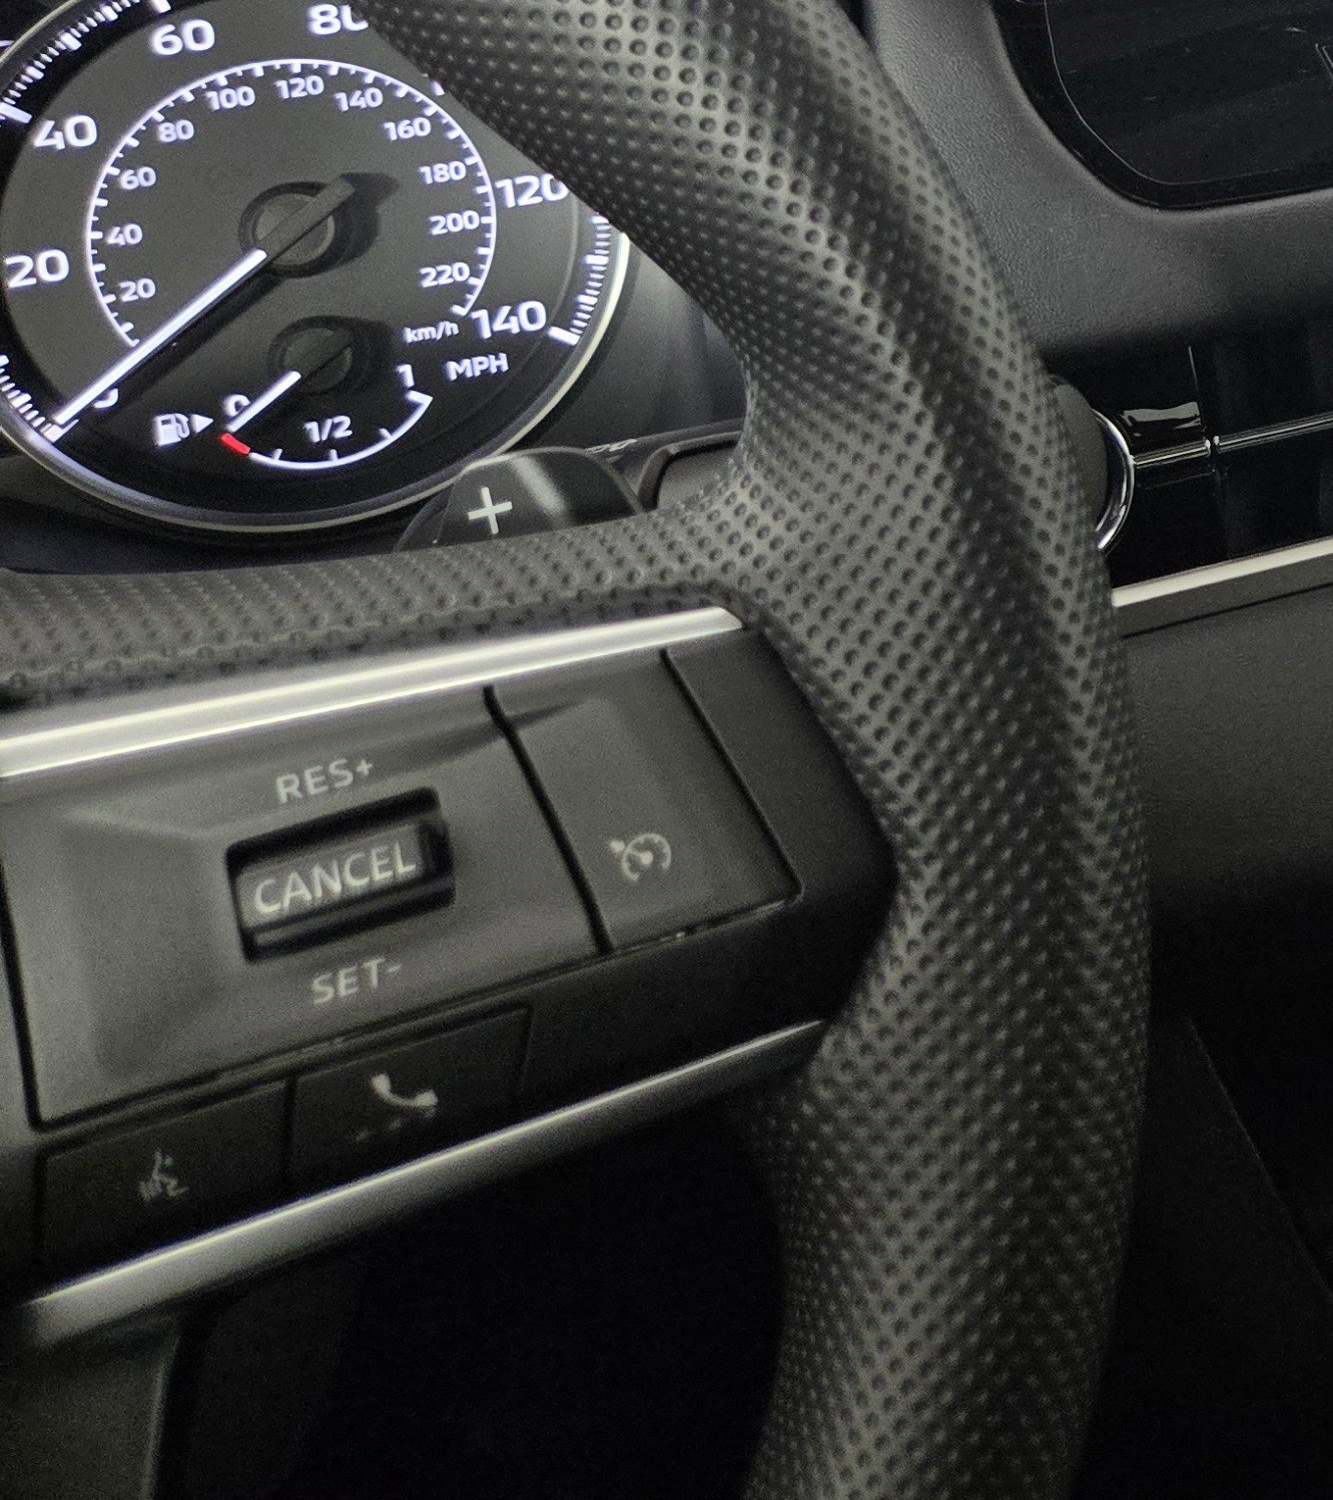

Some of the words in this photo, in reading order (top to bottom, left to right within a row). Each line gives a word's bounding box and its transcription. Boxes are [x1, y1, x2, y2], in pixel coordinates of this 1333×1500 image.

[151, 19, 216, 56] 60
[205, 86, 256, 112] 100
[275, 76, 325, 100] 120
[334, 88, 384, 113] 140
[32, 115, 98, 150] 40
[157, 119, 195, 144] 80
[383, 117, 432, 142] 160
[119, 166, 157, 191] 60
[419, 161, 467, 185] 180
[495, 173, 570, 209] 120
[106, 223, 144, 247] 40
[429, 210, 480, 236] 200
[5, 249, 70, 289] 20
[419, 262, 471, 289] 220
[119, 278, 157, 302] 20
[403, 321, 460, 344] km/h
[470, 300, 548, 341] 140
[445, 353, 509, 382] MPH
[304, 415, 353, 444] 1/2
[274, 757, 374, 803] RES+
[252, 842, 417, 914] CANCEL
